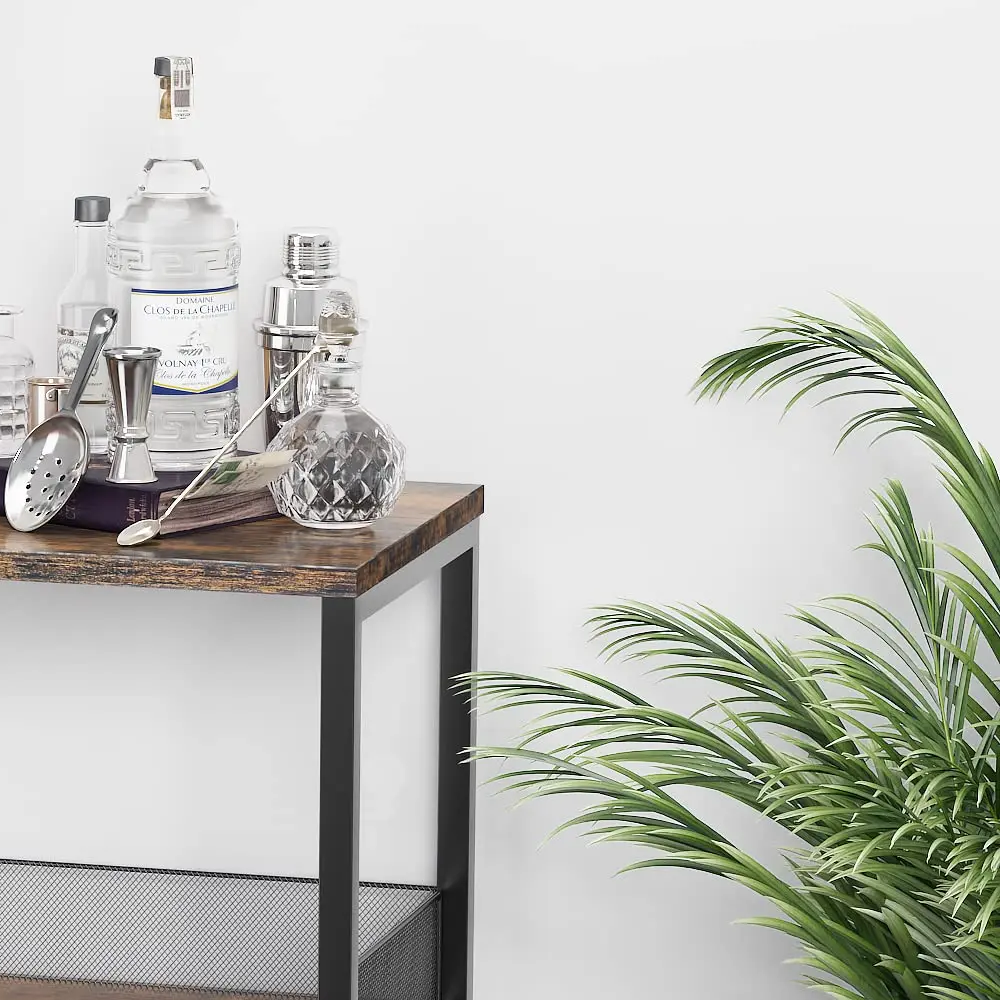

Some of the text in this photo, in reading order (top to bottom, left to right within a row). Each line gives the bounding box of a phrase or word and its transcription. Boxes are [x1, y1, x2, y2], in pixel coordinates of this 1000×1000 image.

[176, 296, 214, 305] DOMAINE
[143, 305, 171, 315] CLOS
[158, 359, 199, 368] VOLNAY
